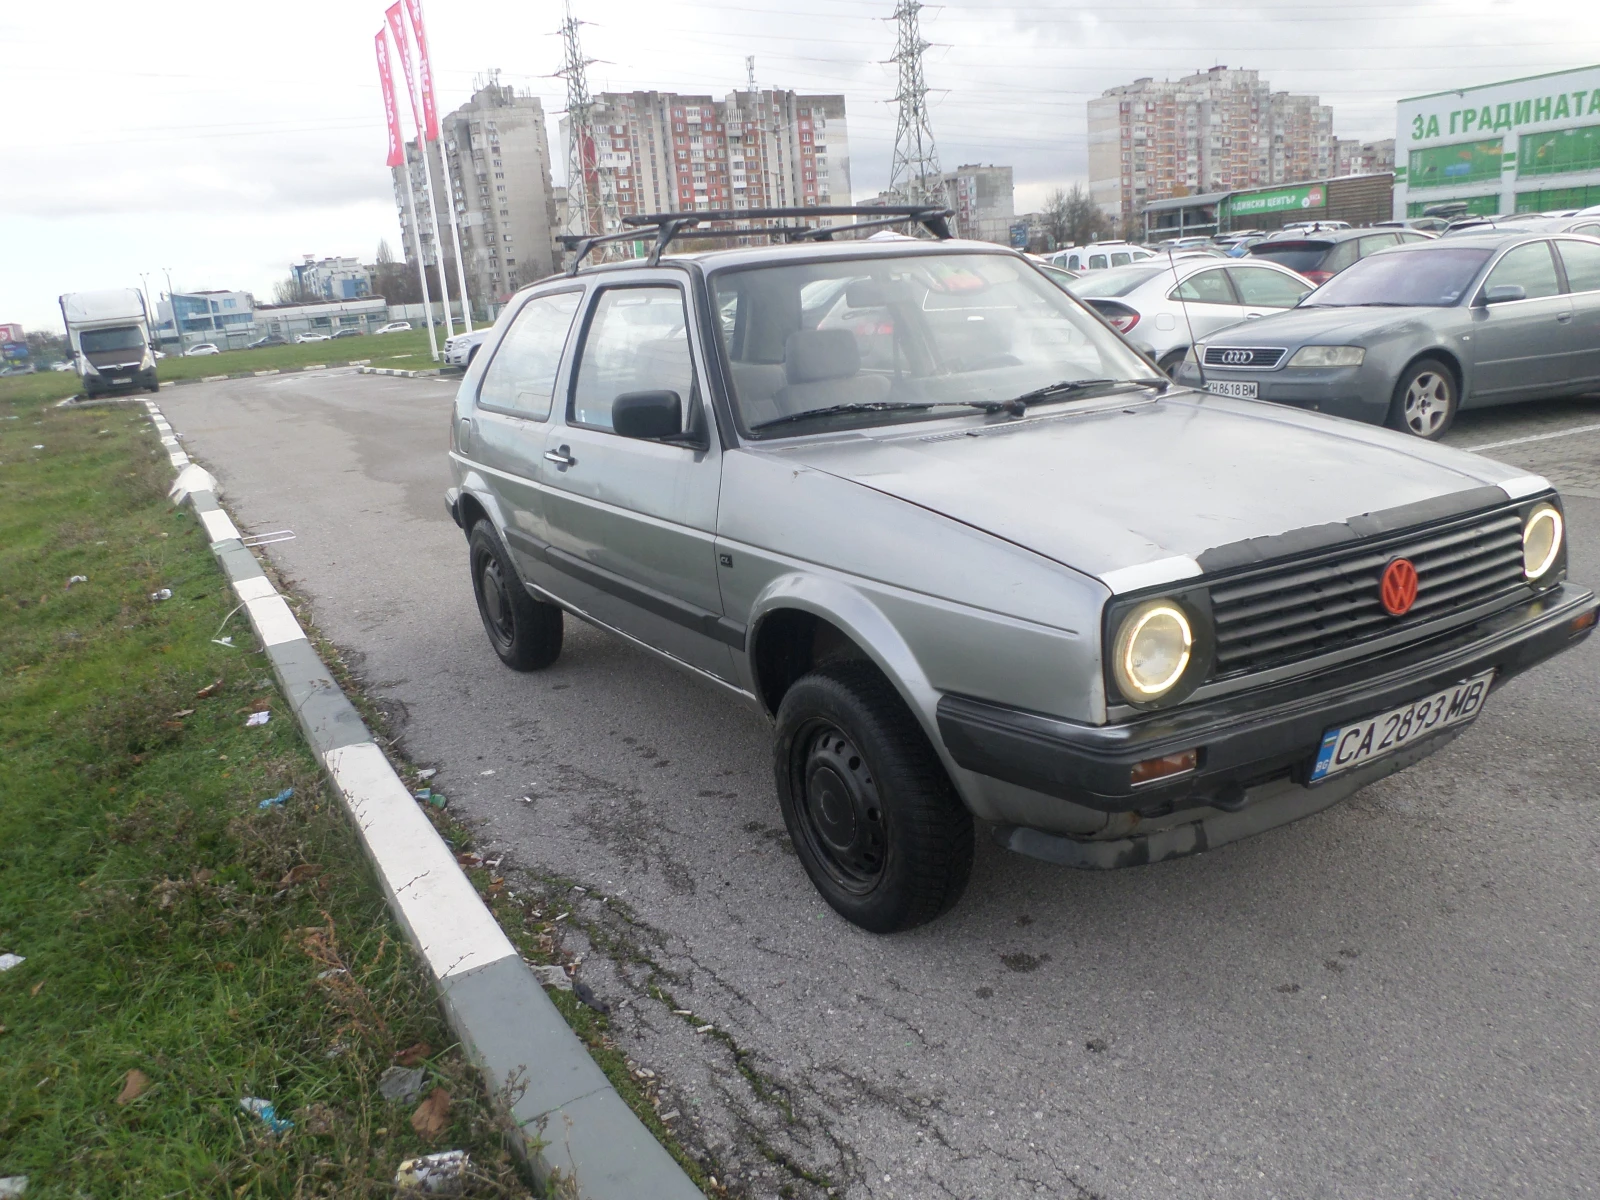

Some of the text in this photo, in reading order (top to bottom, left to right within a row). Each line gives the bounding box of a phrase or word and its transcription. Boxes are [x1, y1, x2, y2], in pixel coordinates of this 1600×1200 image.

[1411, 88, 1600, 141] ЗА ГРАДИНАТА
[1225, 199, 1265, 211] АДИНСКИ
[1219, 383, 1241, 396] 8618
[1242, 384, 1256, 397] BM
[1335, 681, 1485, 765] CA 2893 MB
[1315, 759, 1330, 772] BG
